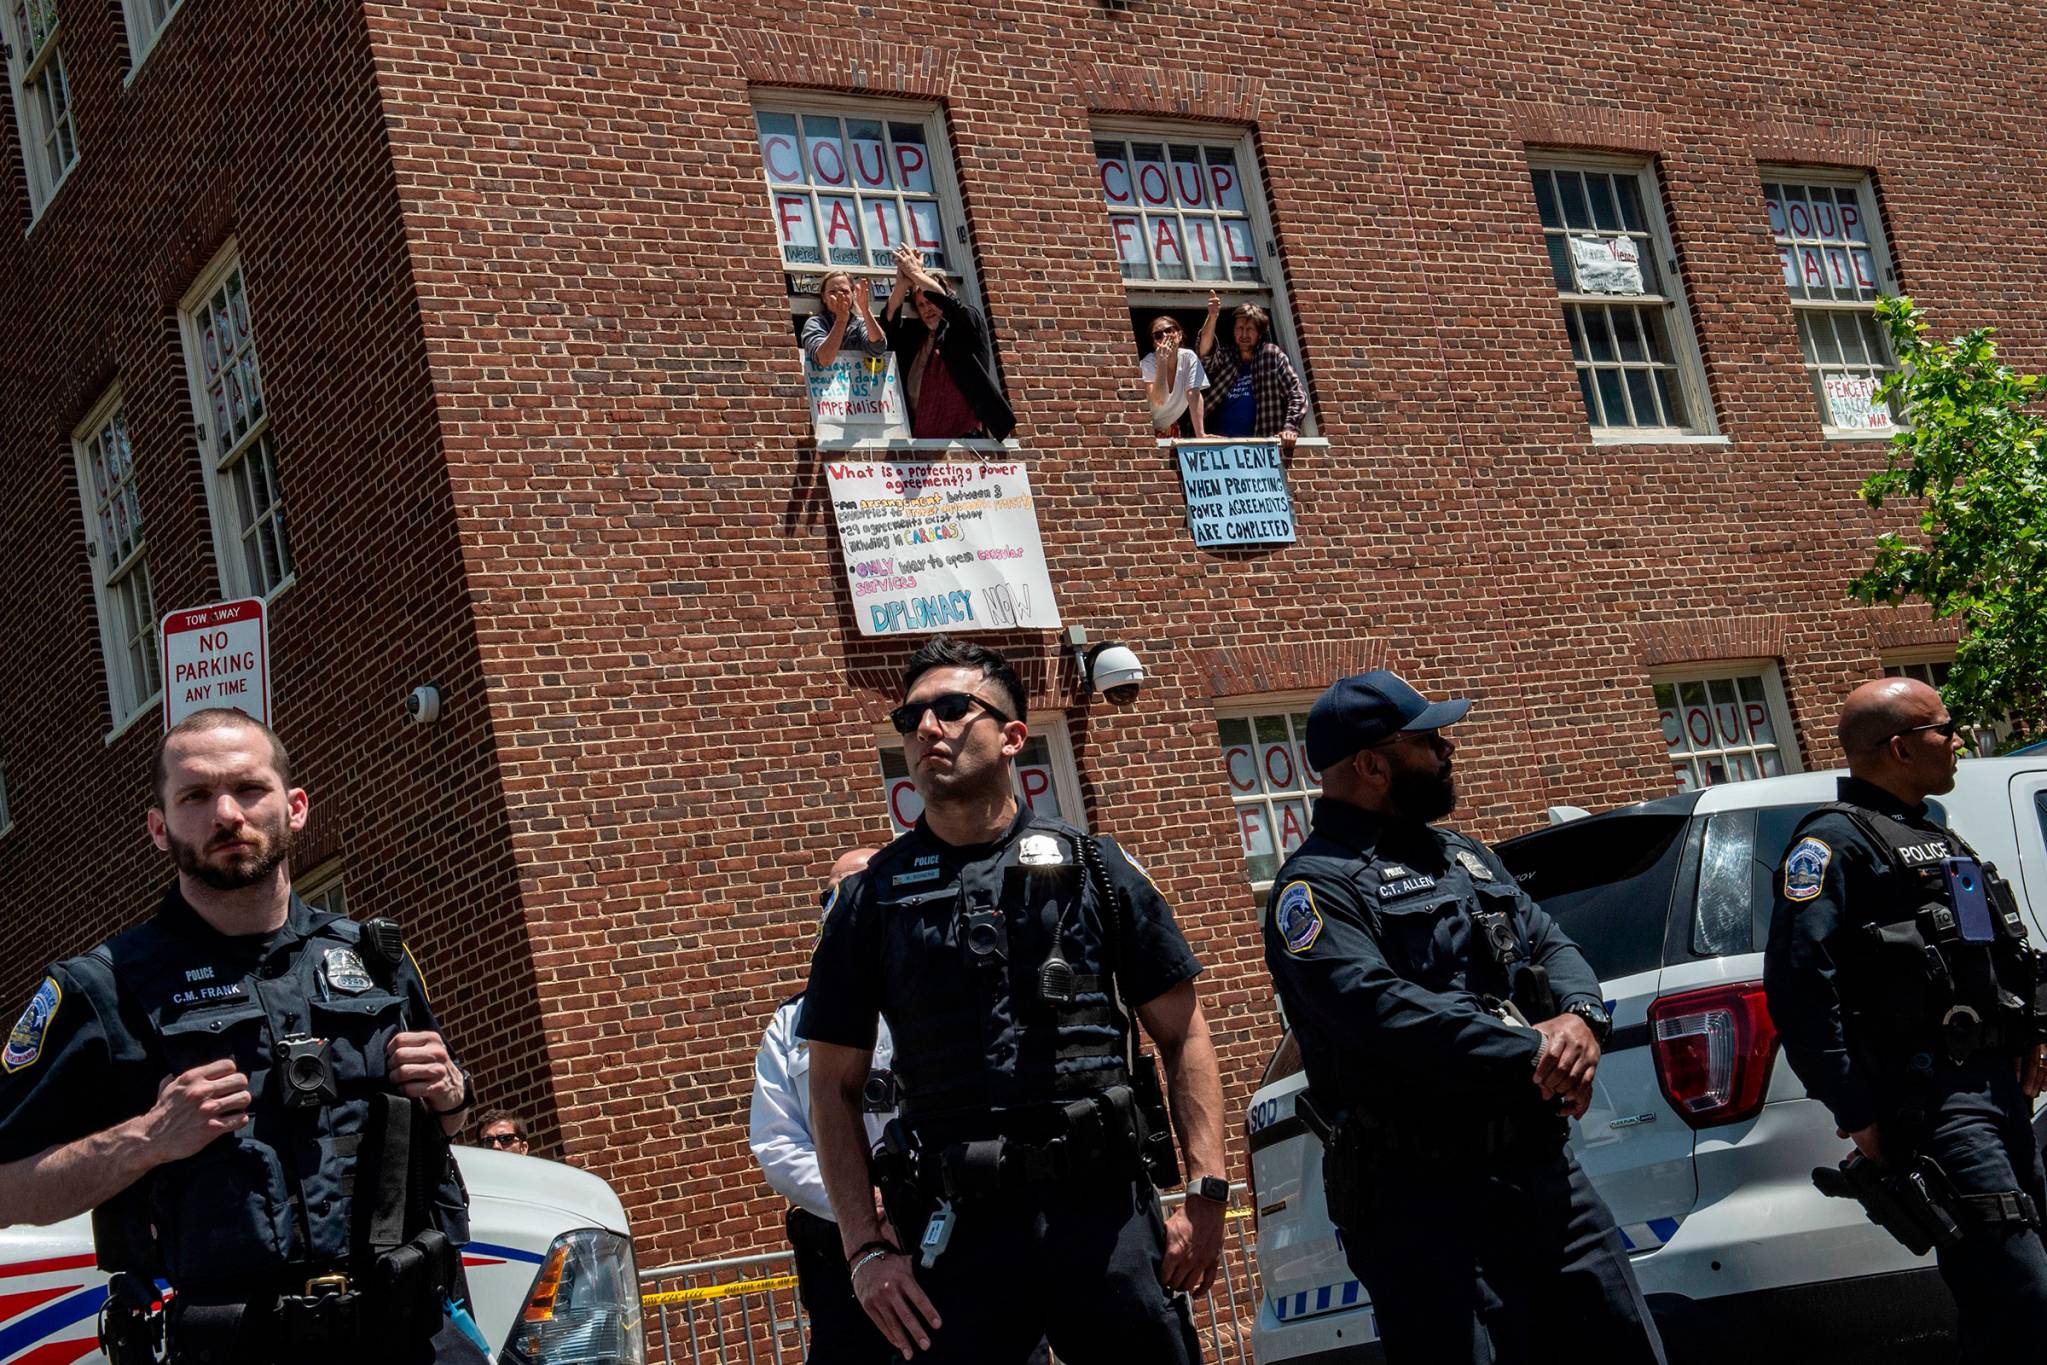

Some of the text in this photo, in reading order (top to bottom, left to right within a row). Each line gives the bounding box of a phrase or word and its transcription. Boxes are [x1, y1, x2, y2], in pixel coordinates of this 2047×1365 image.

[765, 136, 924, 188] COUP
[1100, 161, 1233, 207] COUP
[777, 197, 940, 248] FAIL
[1766, 201, 1858, 239] COUP
[1113, 218, 1254, 263] FAIL
[1825, 380, 1876, 399] PEACEFU
[1867, 414, 1888, 428] WAR
[828, 463, 1018, 481] What is a protecting power
[1184, 447, 1279, 474] WE'LL LEAVE
[886, 474, 964, 494] agreement?
[1186, 476, 1283, 499] WHEN PROTECTING
[860, 491, 942, 510] arrangement
[946, 489, 992, 503] between
[1190, 496, 1288, 520] POWER AGREEMENTS
[845, 523, 860, 537] 29
[862, 517, 923, 535] agreements
[925, 512, 952, 525] exist
[1197, 520, 1289, 542] ARE COMPLETED
[856, 558, 895, 577] ONLY
[927, 554, 944, 569] to
[946, 551, 975, 569] open
[855, 575, 918, 598] services
[185, 612, 208, 627] TOW
[869, 583, 1032, 633] DIPLOMACY NOW
[199, 631, 229, 653] NO
[175, 651, 255, 683] PARKING
[185, 678, 248, 703] ANY TIME
[1660, 703, 1765, 747] COUP
[1225, 745, 1323, 793] COU
[913, 854, 940, 867] POLICE
[1898, 842, 1952, 864] POLICE
[1380, 875, 1435, 897] C.T. ALLEN
[185, 966, 216, 983] POLICE
[173, 983, 241, 1004] C.M. FRANK
[1251, 1097, 1278, 1132] SOD
